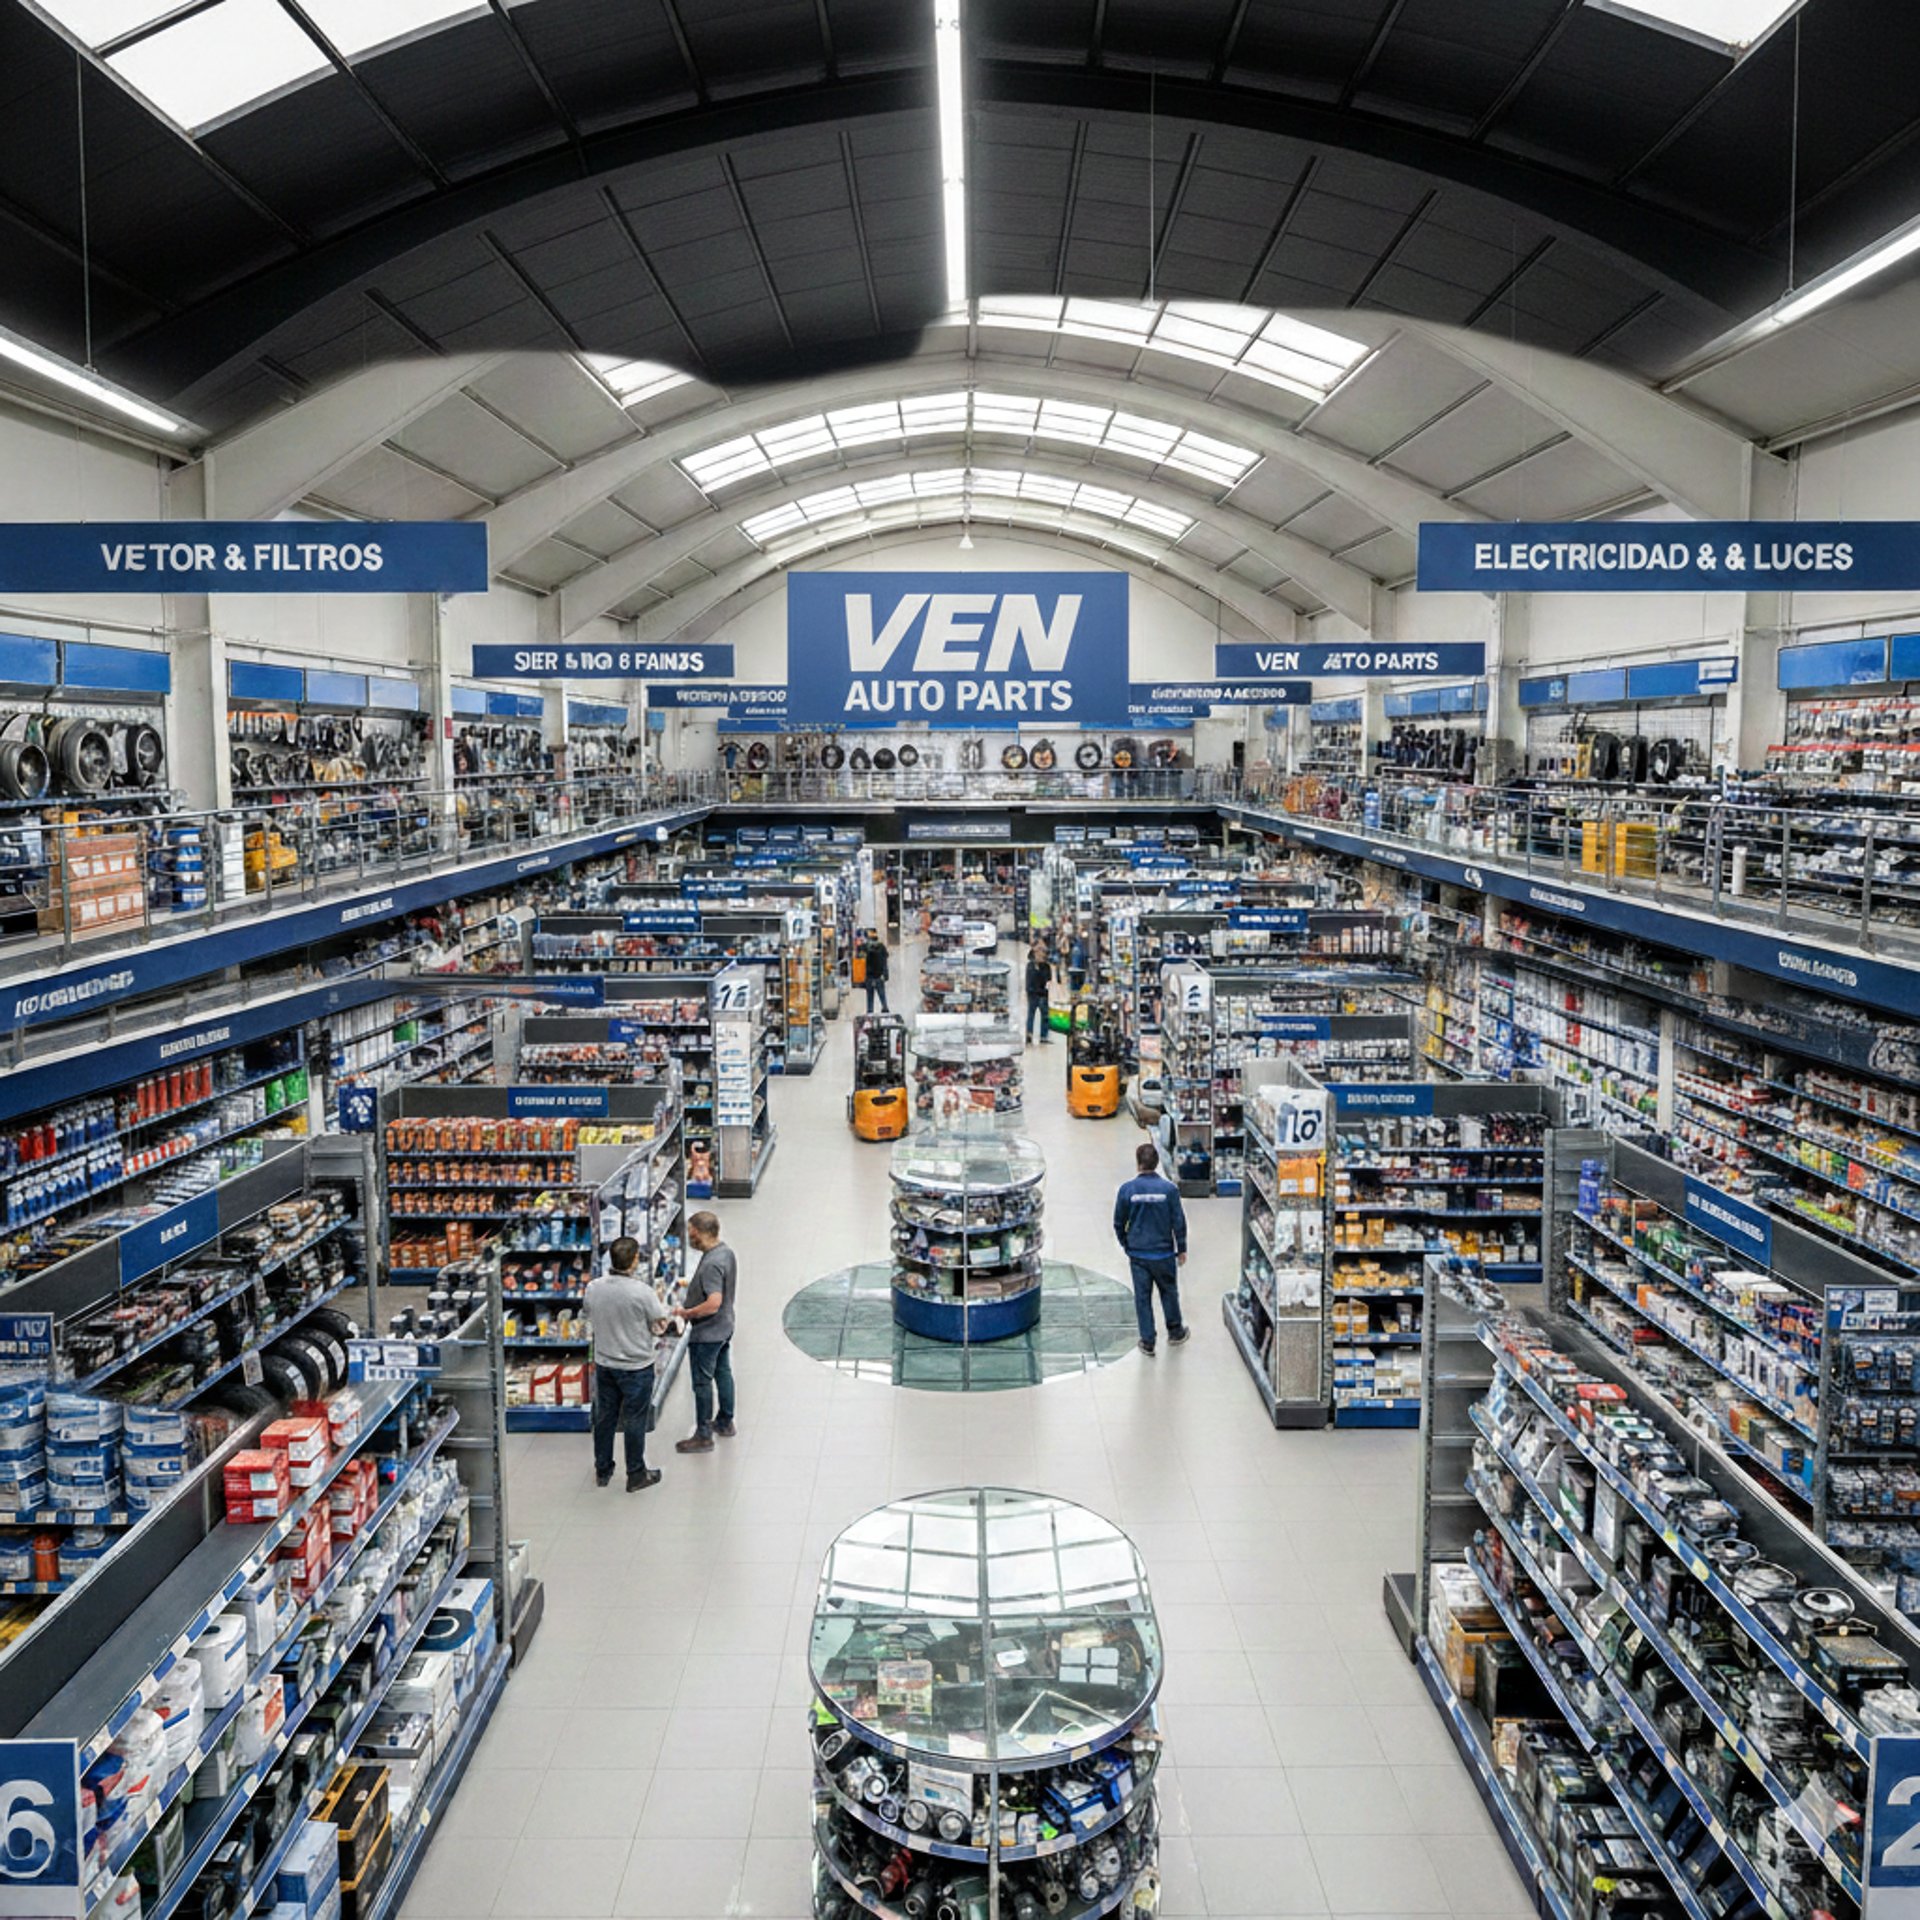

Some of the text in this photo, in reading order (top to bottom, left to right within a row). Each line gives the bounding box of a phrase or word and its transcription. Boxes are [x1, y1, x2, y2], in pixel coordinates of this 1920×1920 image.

[100, 543, 384, 571] VETOR & FILTROS
[1474, 543, 1854, 571] ELECTRICIDAD & & LUCES
[844, 593, 1083, 672] VEN
[1255, 652, 1300, 670] VEN
[1374, 652, 1439, 670] PARTS
[843, 679, 1073, 712] AUTO PARTS
[0, 1779, 55, 1879] 6
